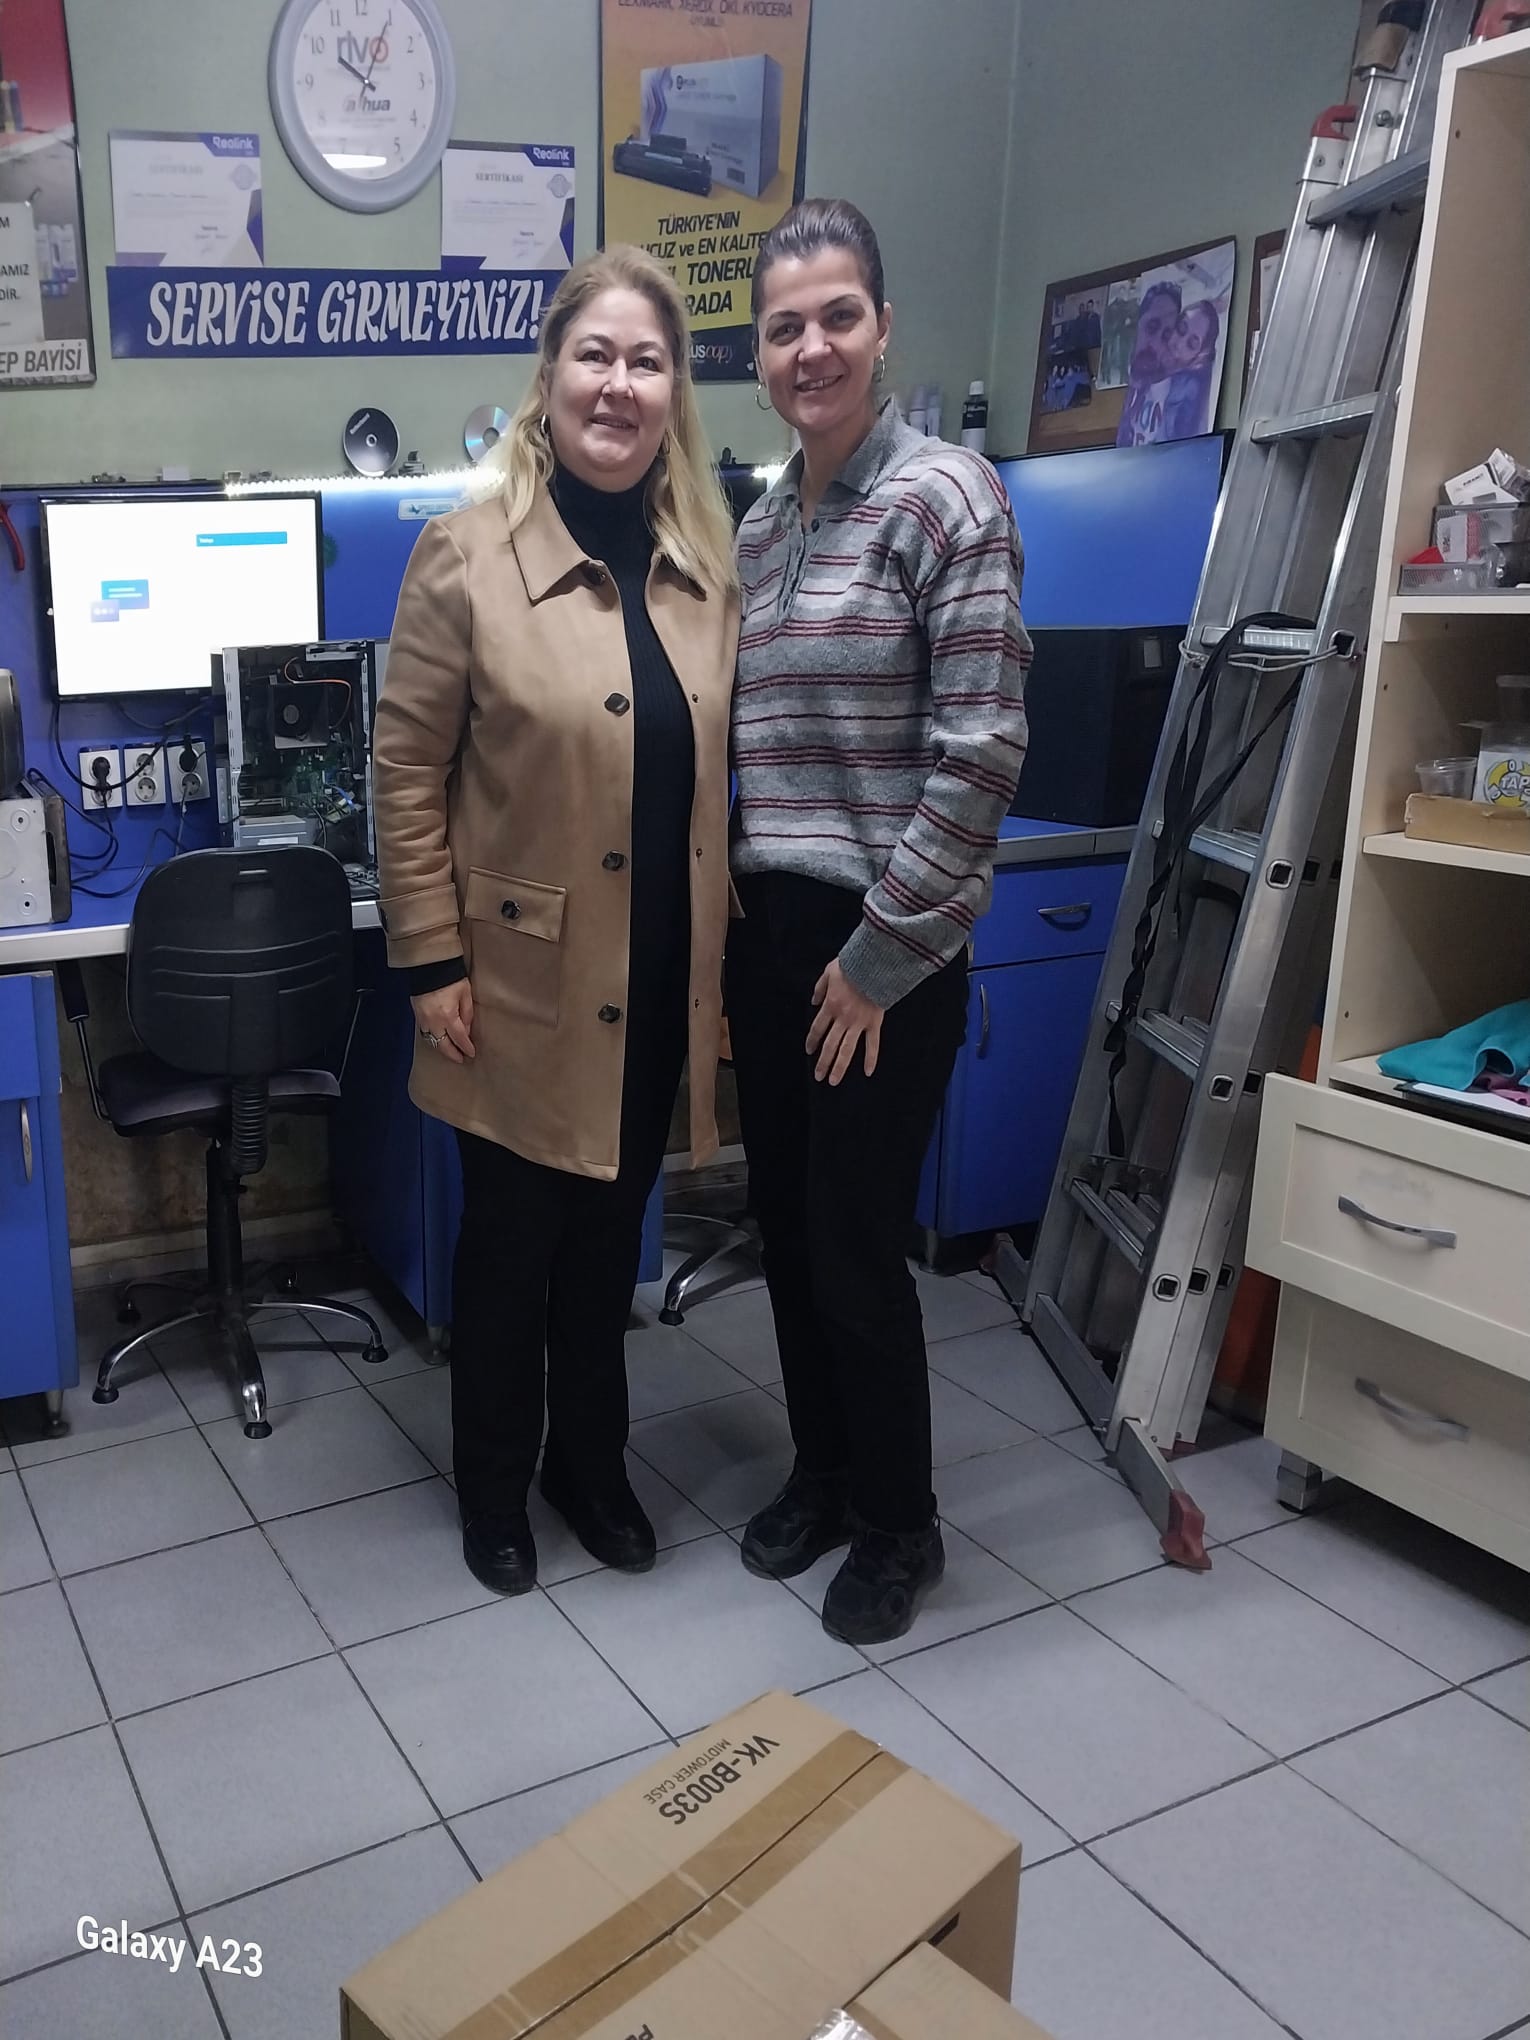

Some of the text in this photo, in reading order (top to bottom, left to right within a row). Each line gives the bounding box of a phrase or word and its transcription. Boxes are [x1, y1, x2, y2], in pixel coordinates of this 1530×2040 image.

[311, 36, 325, 55] 10
[407, 36, 414, 53] 2
[305, 73, 314, 91] 9
[417, 72, 425, 90] 3
[410, 109, 418, 127] 4
[212, 136, 254, 150] Reolink
[393, 137, 400, 153] 5
[533, 147, 570, 160] Reolink
[679, 243, 694, 257] ve
[698, 237, 717, 255] EN
[687, 257, 754, 286] TONERL
[685, 290, 733, 317] RADA
[24, 343, 82, 373] BAYİSİ
[642, 1738, 732, 1805] MIDTOWER CASE
[659, 1735, 780, 1825] VK-B003S
